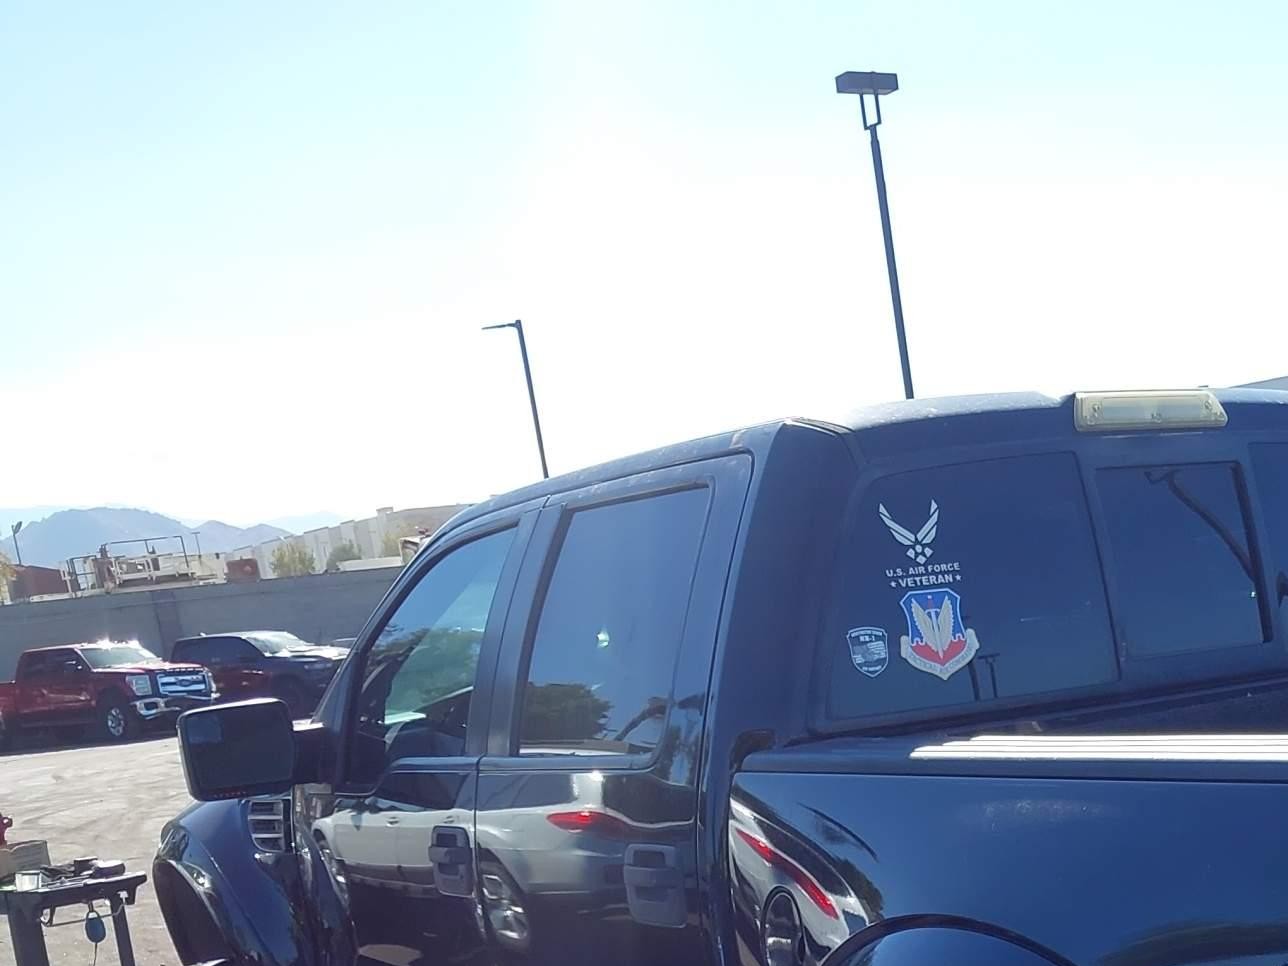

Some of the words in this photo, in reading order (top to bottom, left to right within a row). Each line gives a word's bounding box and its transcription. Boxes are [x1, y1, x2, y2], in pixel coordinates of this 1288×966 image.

[886, 569, 905, 577] U.S.
[909, 566, 925, 575] AIR
[928, 562, 960, 573] FORCE
[899, 574, 953, 587] VETERAN
